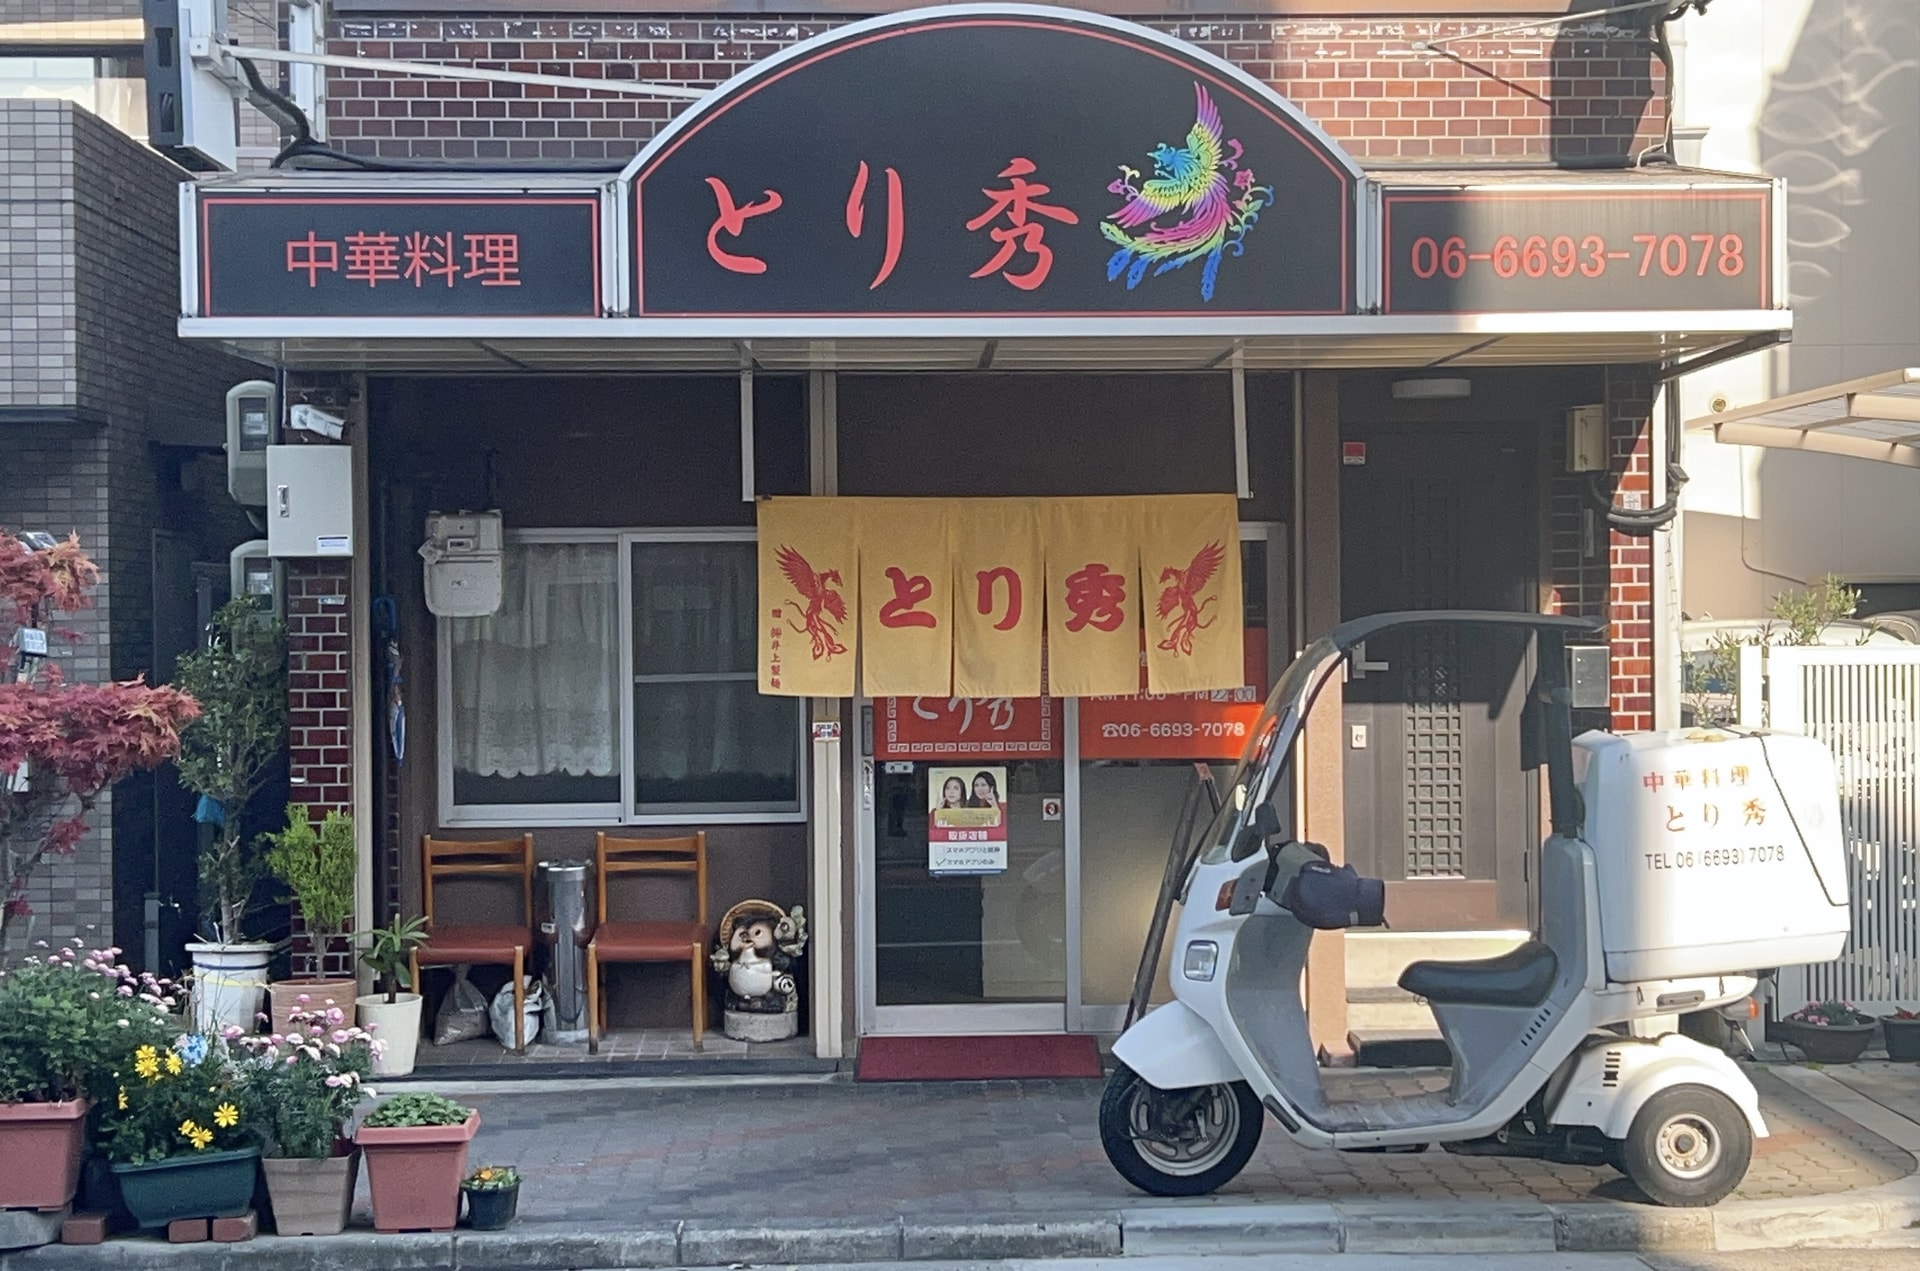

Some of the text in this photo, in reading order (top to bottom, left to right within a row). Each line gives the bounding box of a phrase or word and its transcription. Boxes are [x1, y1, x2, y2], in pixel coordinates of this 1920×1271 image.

[704, 158, 1078, 290] とり秀
[285, 230, 521, 288] 中華料理
[1411, 233, 1744, 279] 06-6693-7078
[879, 563, 1127, 633] とり秀
[1666, 798, 1766, 832] とり秀
[1645, 853, 1671, 869] TEL
